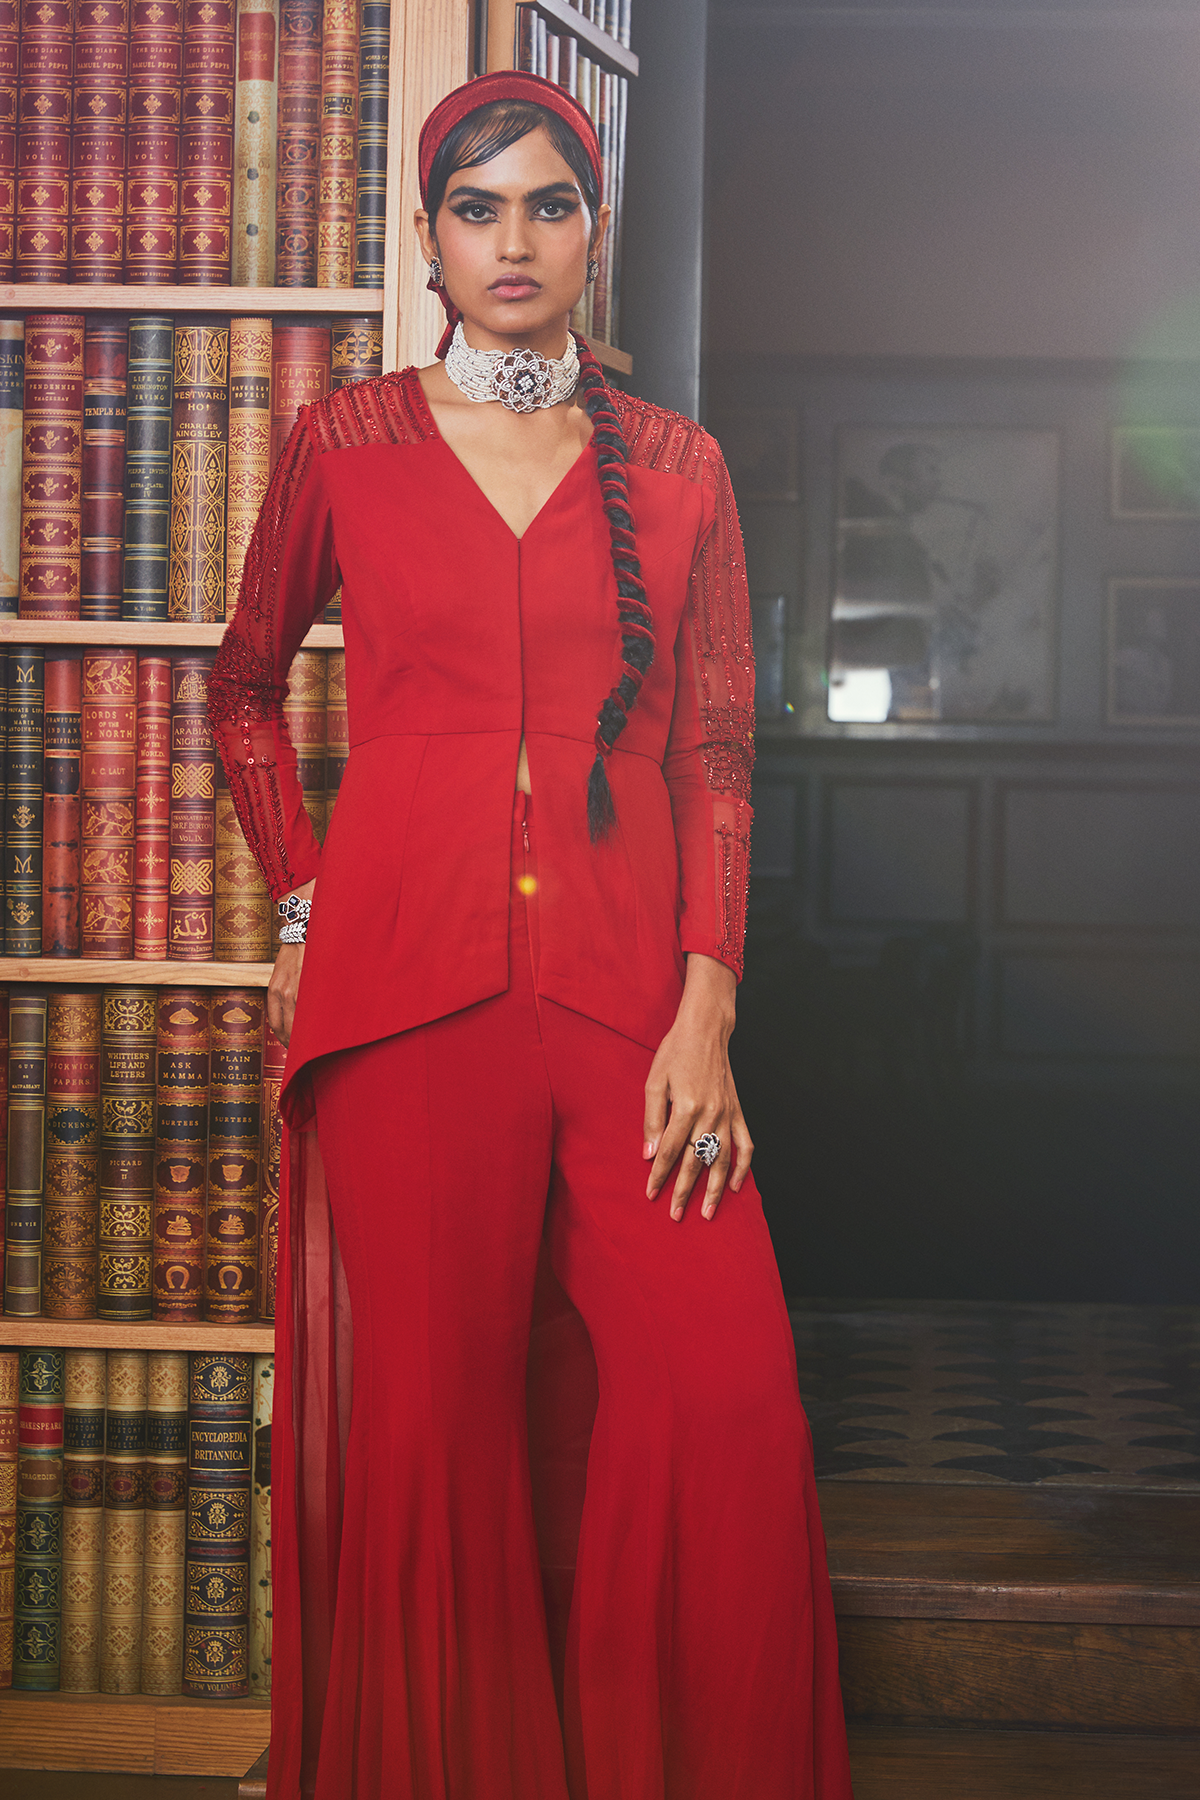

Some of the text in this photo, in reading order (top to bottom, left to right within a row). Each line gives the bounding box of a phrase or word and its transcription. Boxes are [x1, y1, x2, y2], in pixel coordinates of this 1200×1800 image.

[48, 62, 69, 70] PEPYS
[102, 62, 123, 70] PEPYS
[132, 61, 178, 70] SAMUEL PEPYS
[186, 61, 230, 70] SAMUEL PEPYS
[51, 153, 62, 161] III
[281, 368, 321, 377] FIFTY
[280, 380, 321, 389] YEARS
[174, 391, 227, 401] WESTWARD
[187, 403, 210, 411] HO!
[280, 398, 316, 408] SPOR
[85, 407, 114, 416] TEMPLE
[176, 430, 222, 438] KINGSLEY
[86, 711, 117, 719] LORDS
[99, 729, 133, 738] NORTH
[139, 732, 167, 740] CAPITALS
[175, 738, 211, 746] NIGHTS
[107, 1052, 150, 1060] WHITTIER'S
[110, 1061, 127, 1069] LIFE
[110, 1070, 145, 1078] LETTERS
[162, 1072, 203, 1080] MAMMA
[20, 1421, 62, 1430] SHAKESPEARE
[191, 1431, 248, 1443] ENCYCLOPÆDIA
[194, 1449, 244, 1460] BRITANNICA
[190, 1682, 241, 1691] NEW VOLUMES
